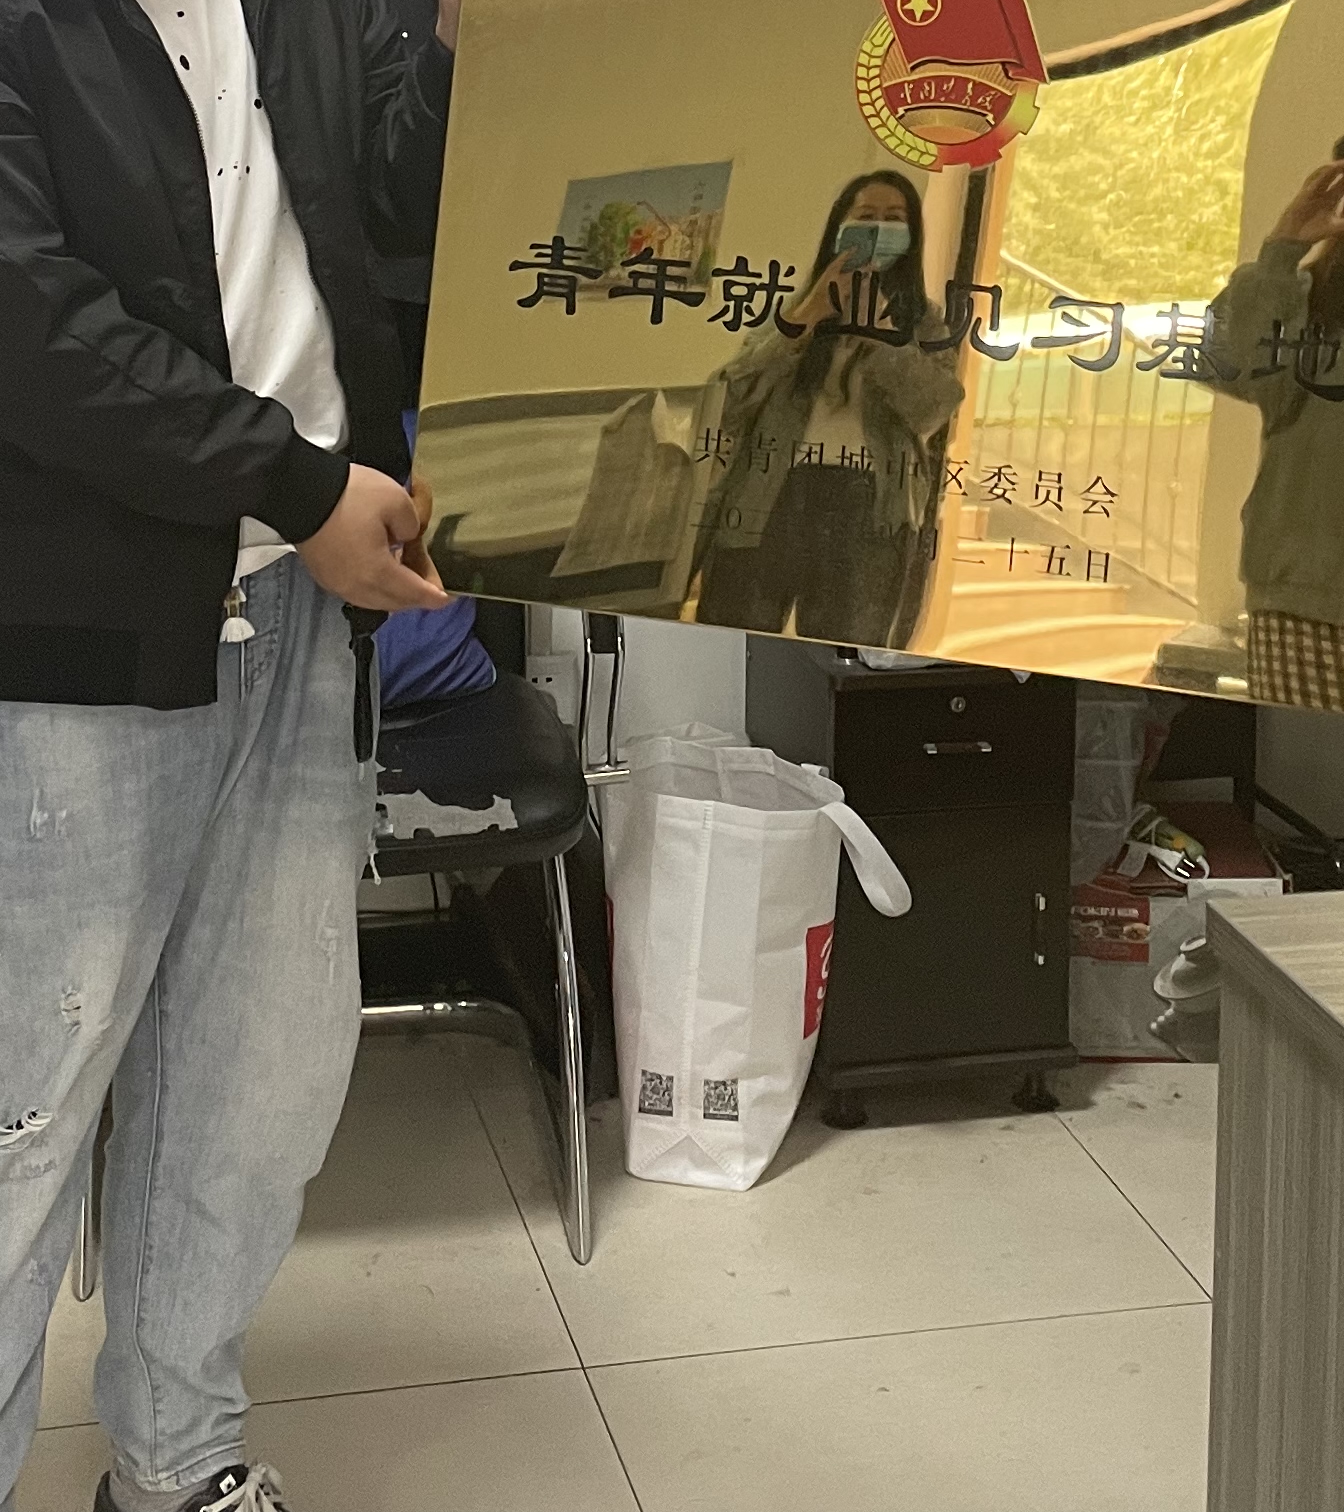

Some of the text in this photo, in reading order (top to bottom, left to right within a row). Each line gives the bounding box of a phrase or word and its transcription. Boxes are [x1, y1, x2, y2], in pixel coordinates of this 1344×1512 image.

[696, 428, 1118, 518] 共青团城中区委员会
